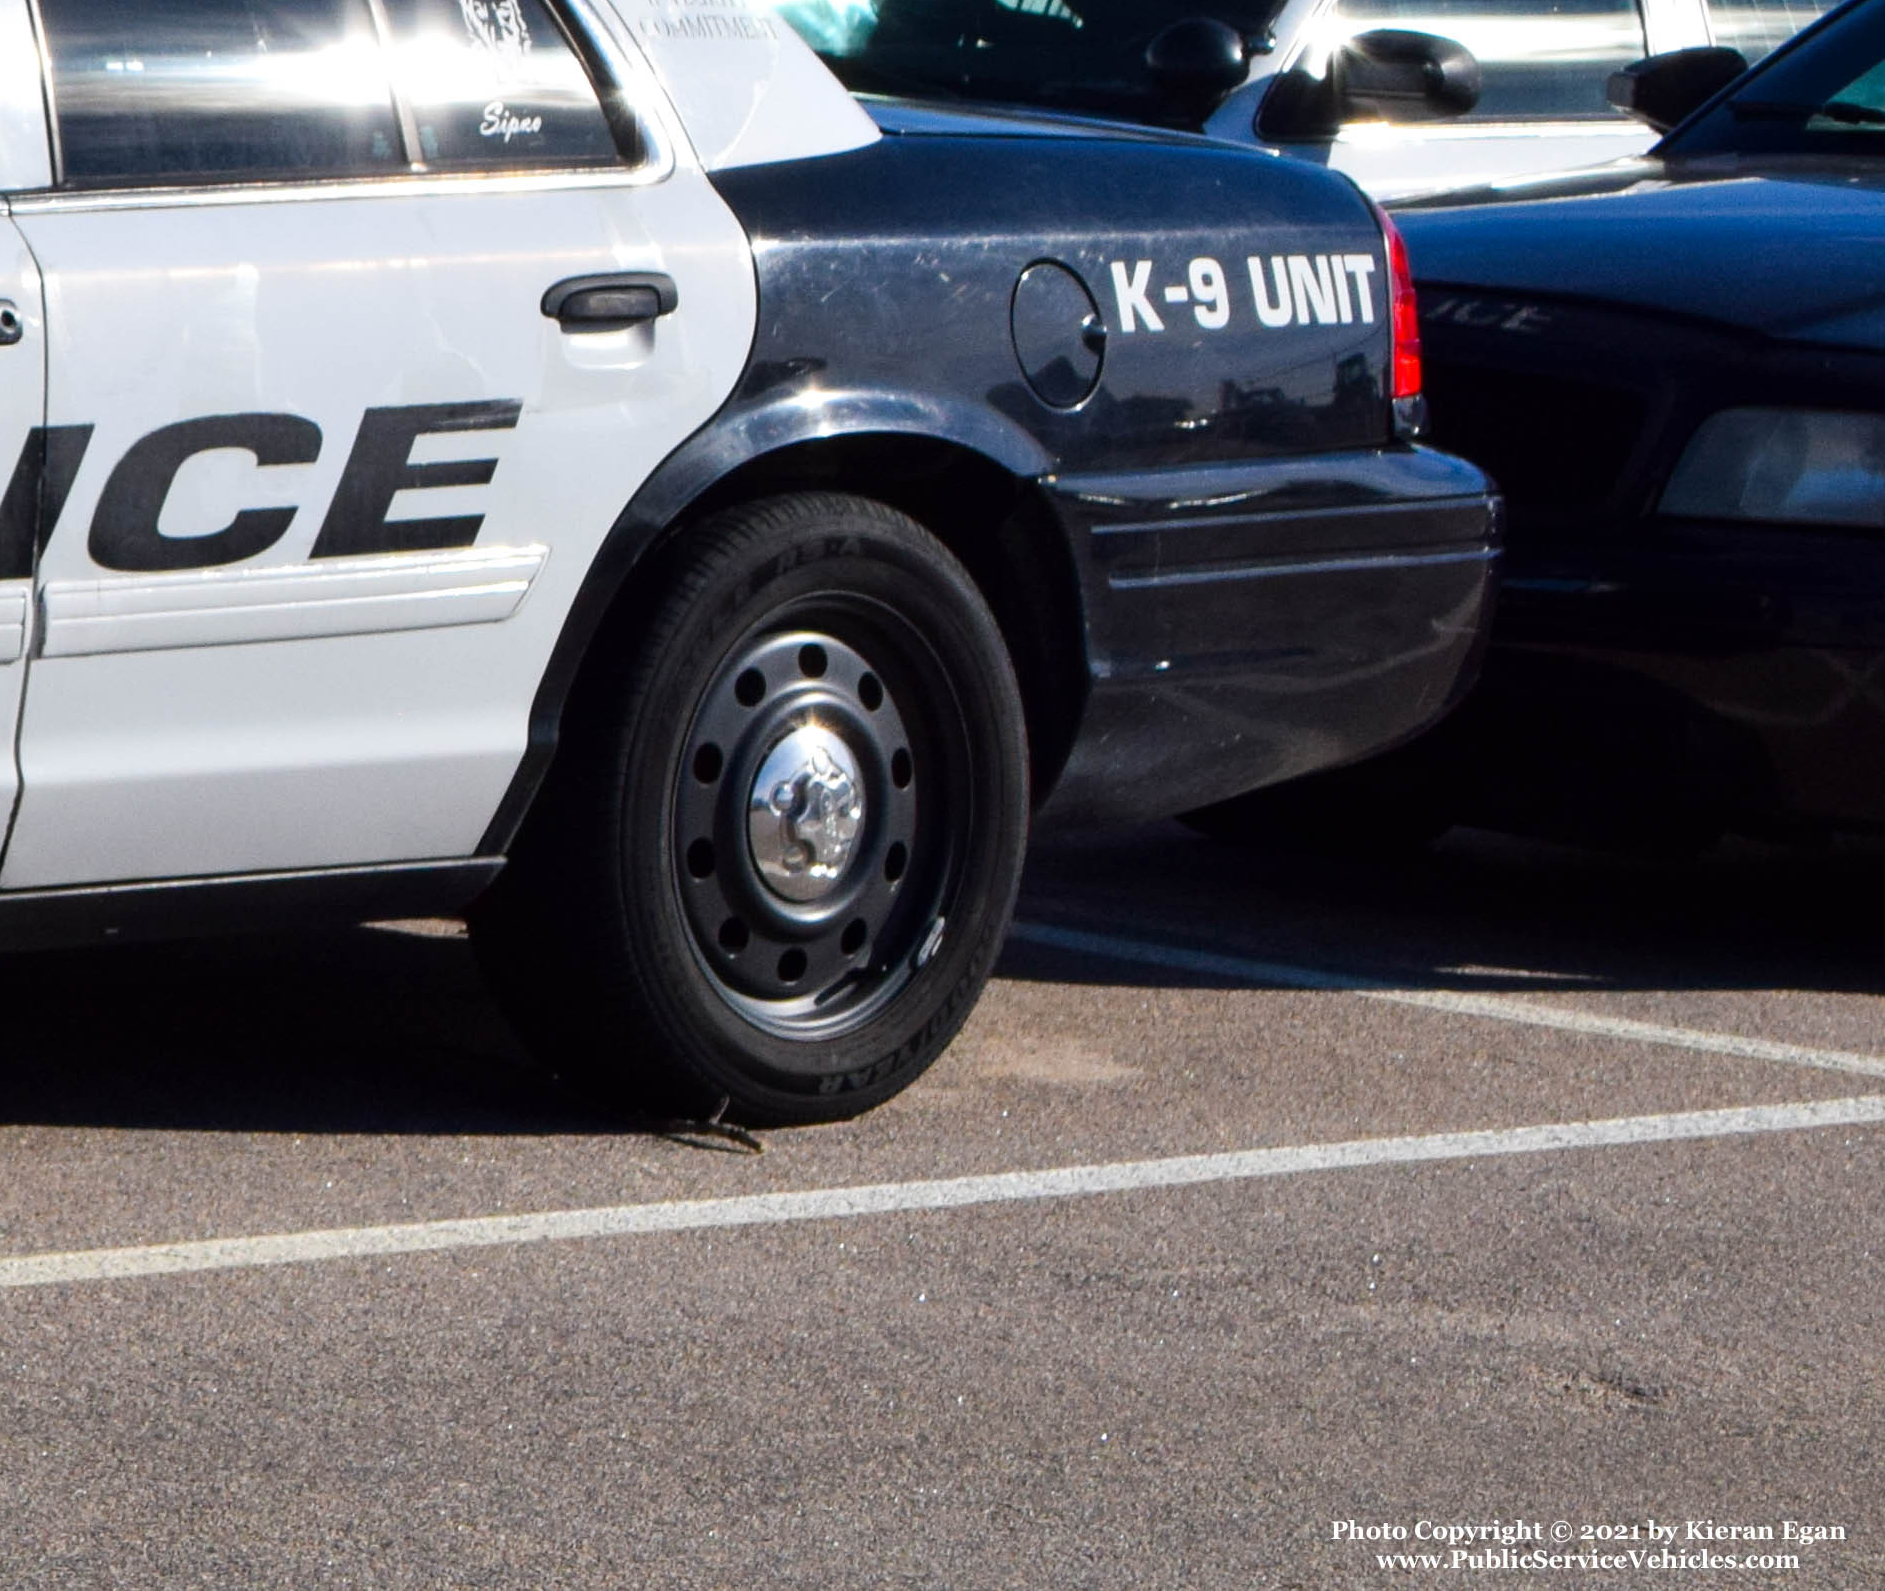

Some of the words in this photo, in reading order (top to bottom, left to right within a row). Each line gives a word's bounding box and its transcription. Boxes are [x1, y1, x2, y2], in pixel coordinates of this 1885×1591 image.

[637, 14, 781, 41] COMMITMENT
[1110, 257, 1230, 333] K-9
[1247, 254, 1376, 329] UNIT
